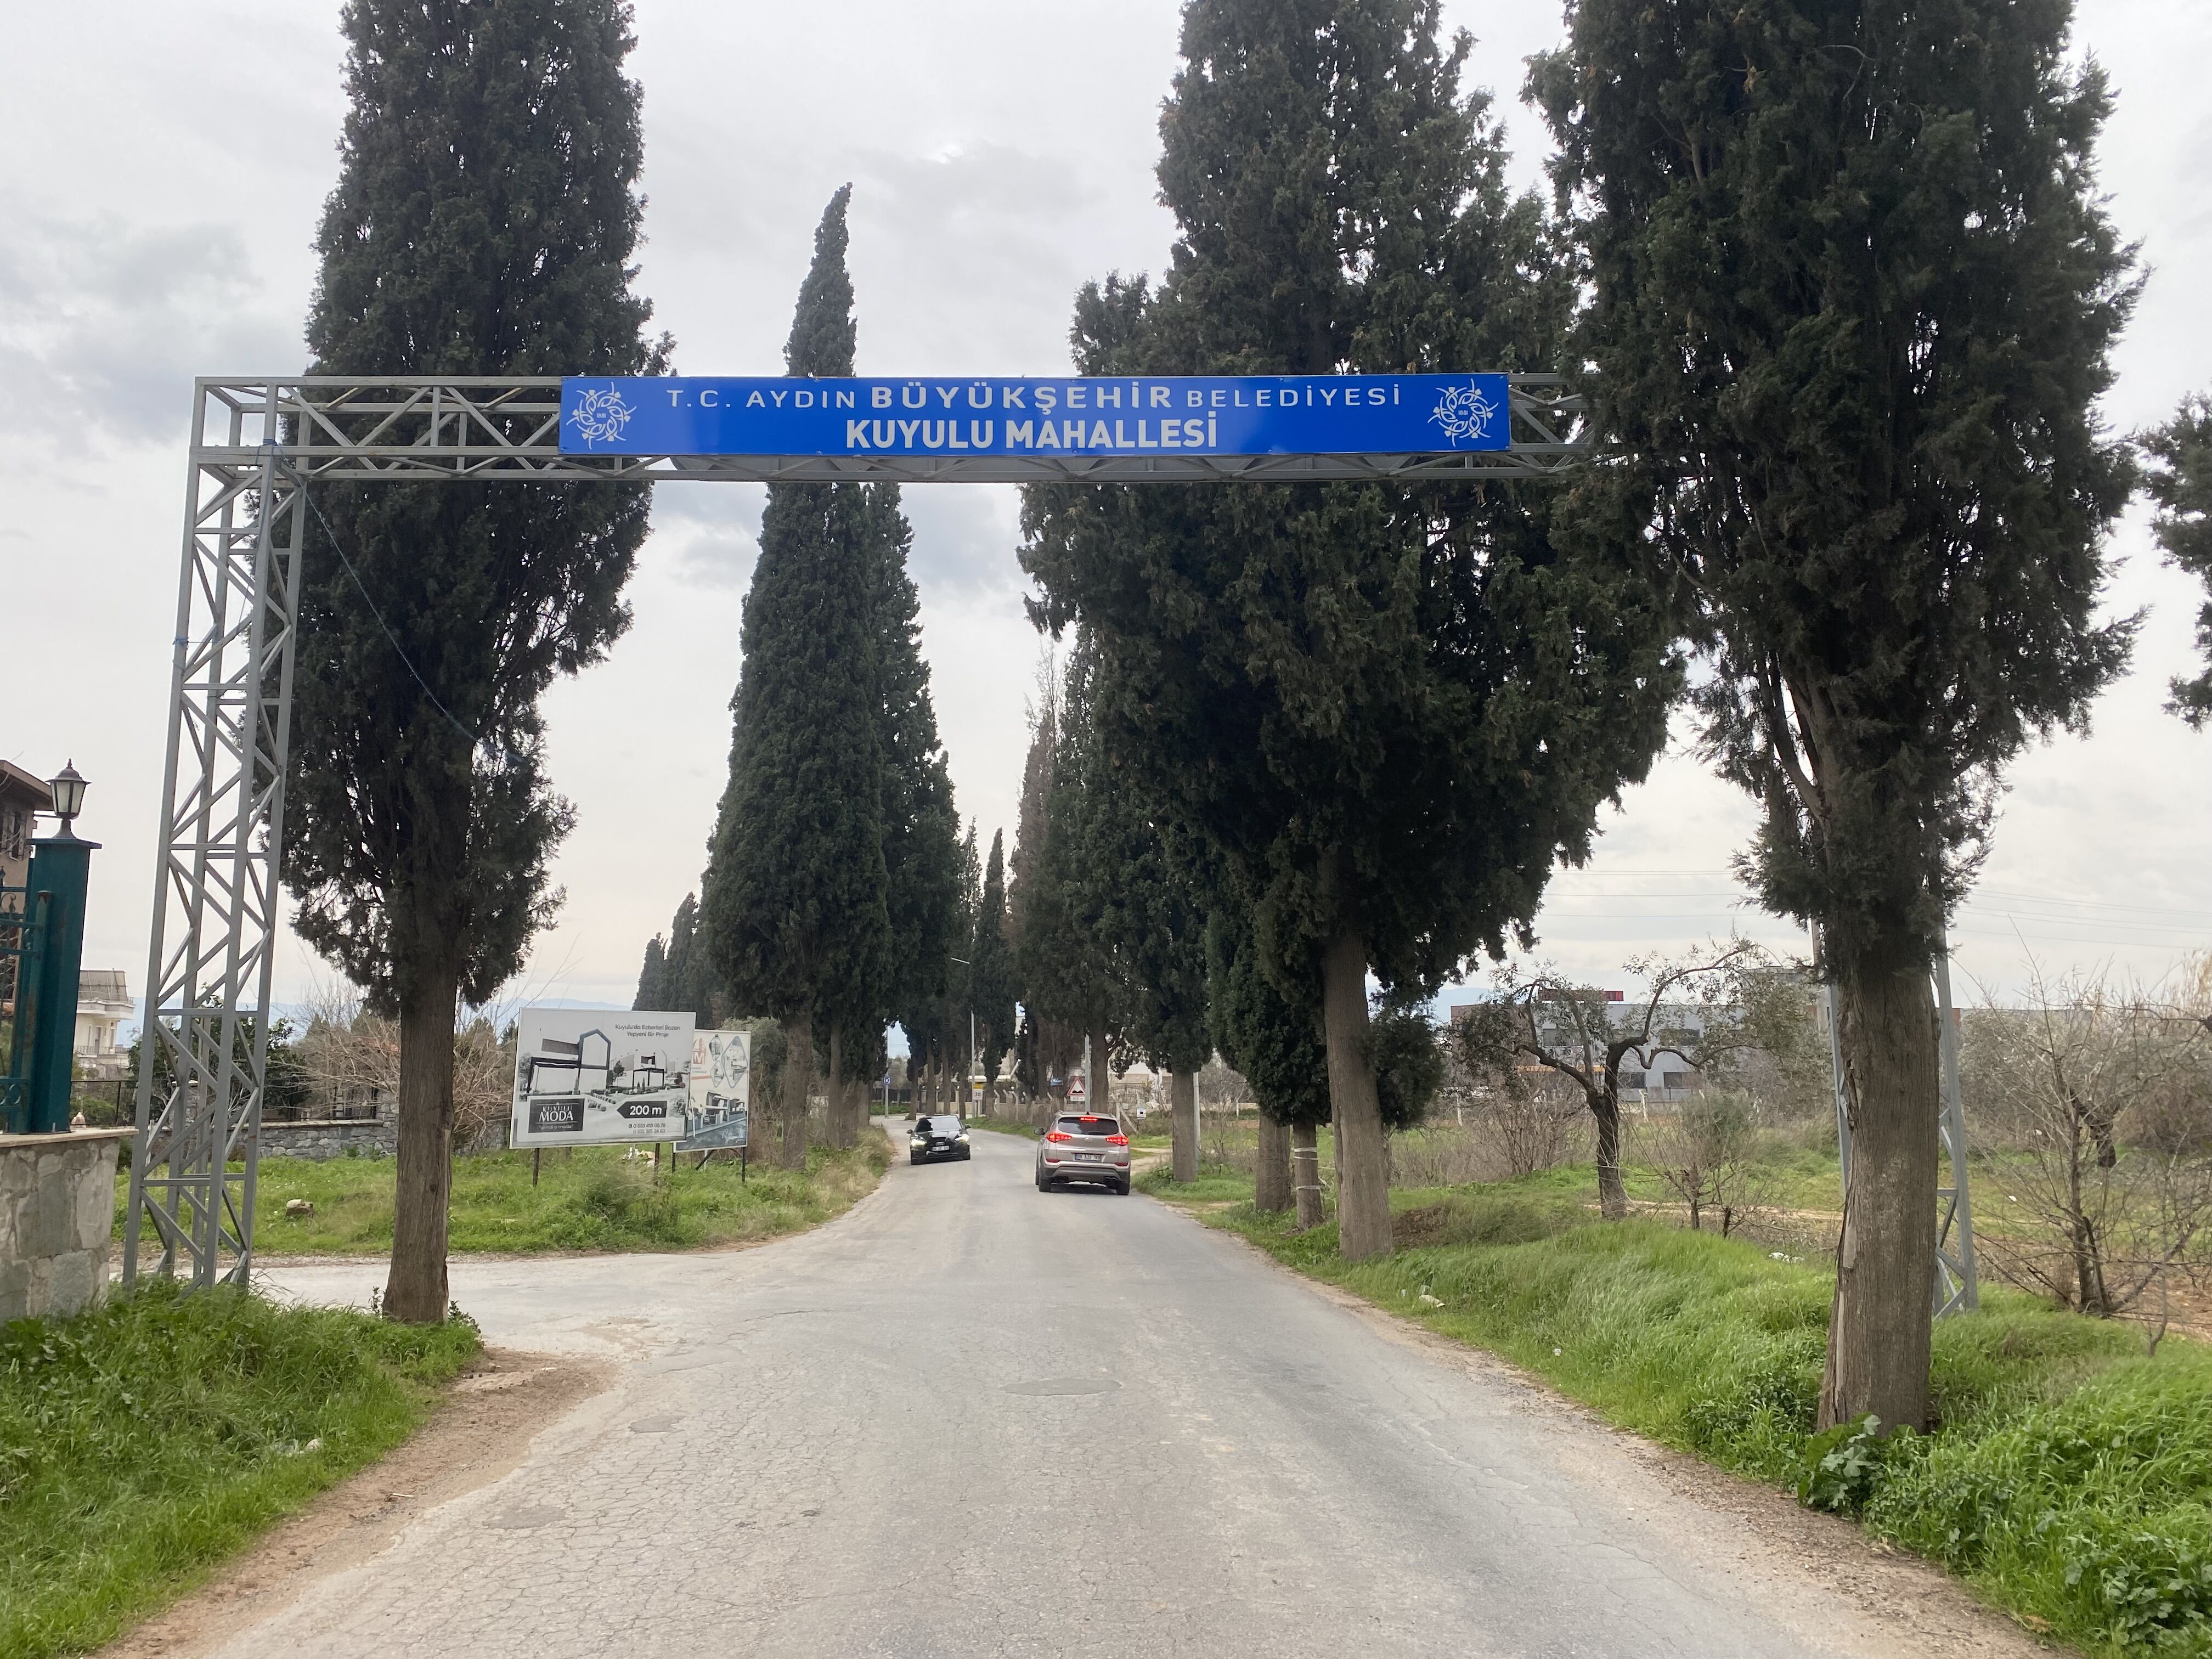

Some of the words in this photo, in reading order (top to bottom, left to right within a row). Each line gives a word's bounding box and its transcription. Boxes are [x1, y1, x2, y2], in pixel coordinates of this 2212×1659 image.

[746, 390, 855, 409] AYDIN
[871, 381, 1172, 414] BÜYÜKŞEHİR
[1187, 384, 1400, 408] BELEDİYESİ
[846, 420, 994, 449] KUYULU
[1006, 411, 1217, 449] MAHALLESİ
[539, 1110, 573, 1122] MODA
[629, 1105, 650, 1115] 200
